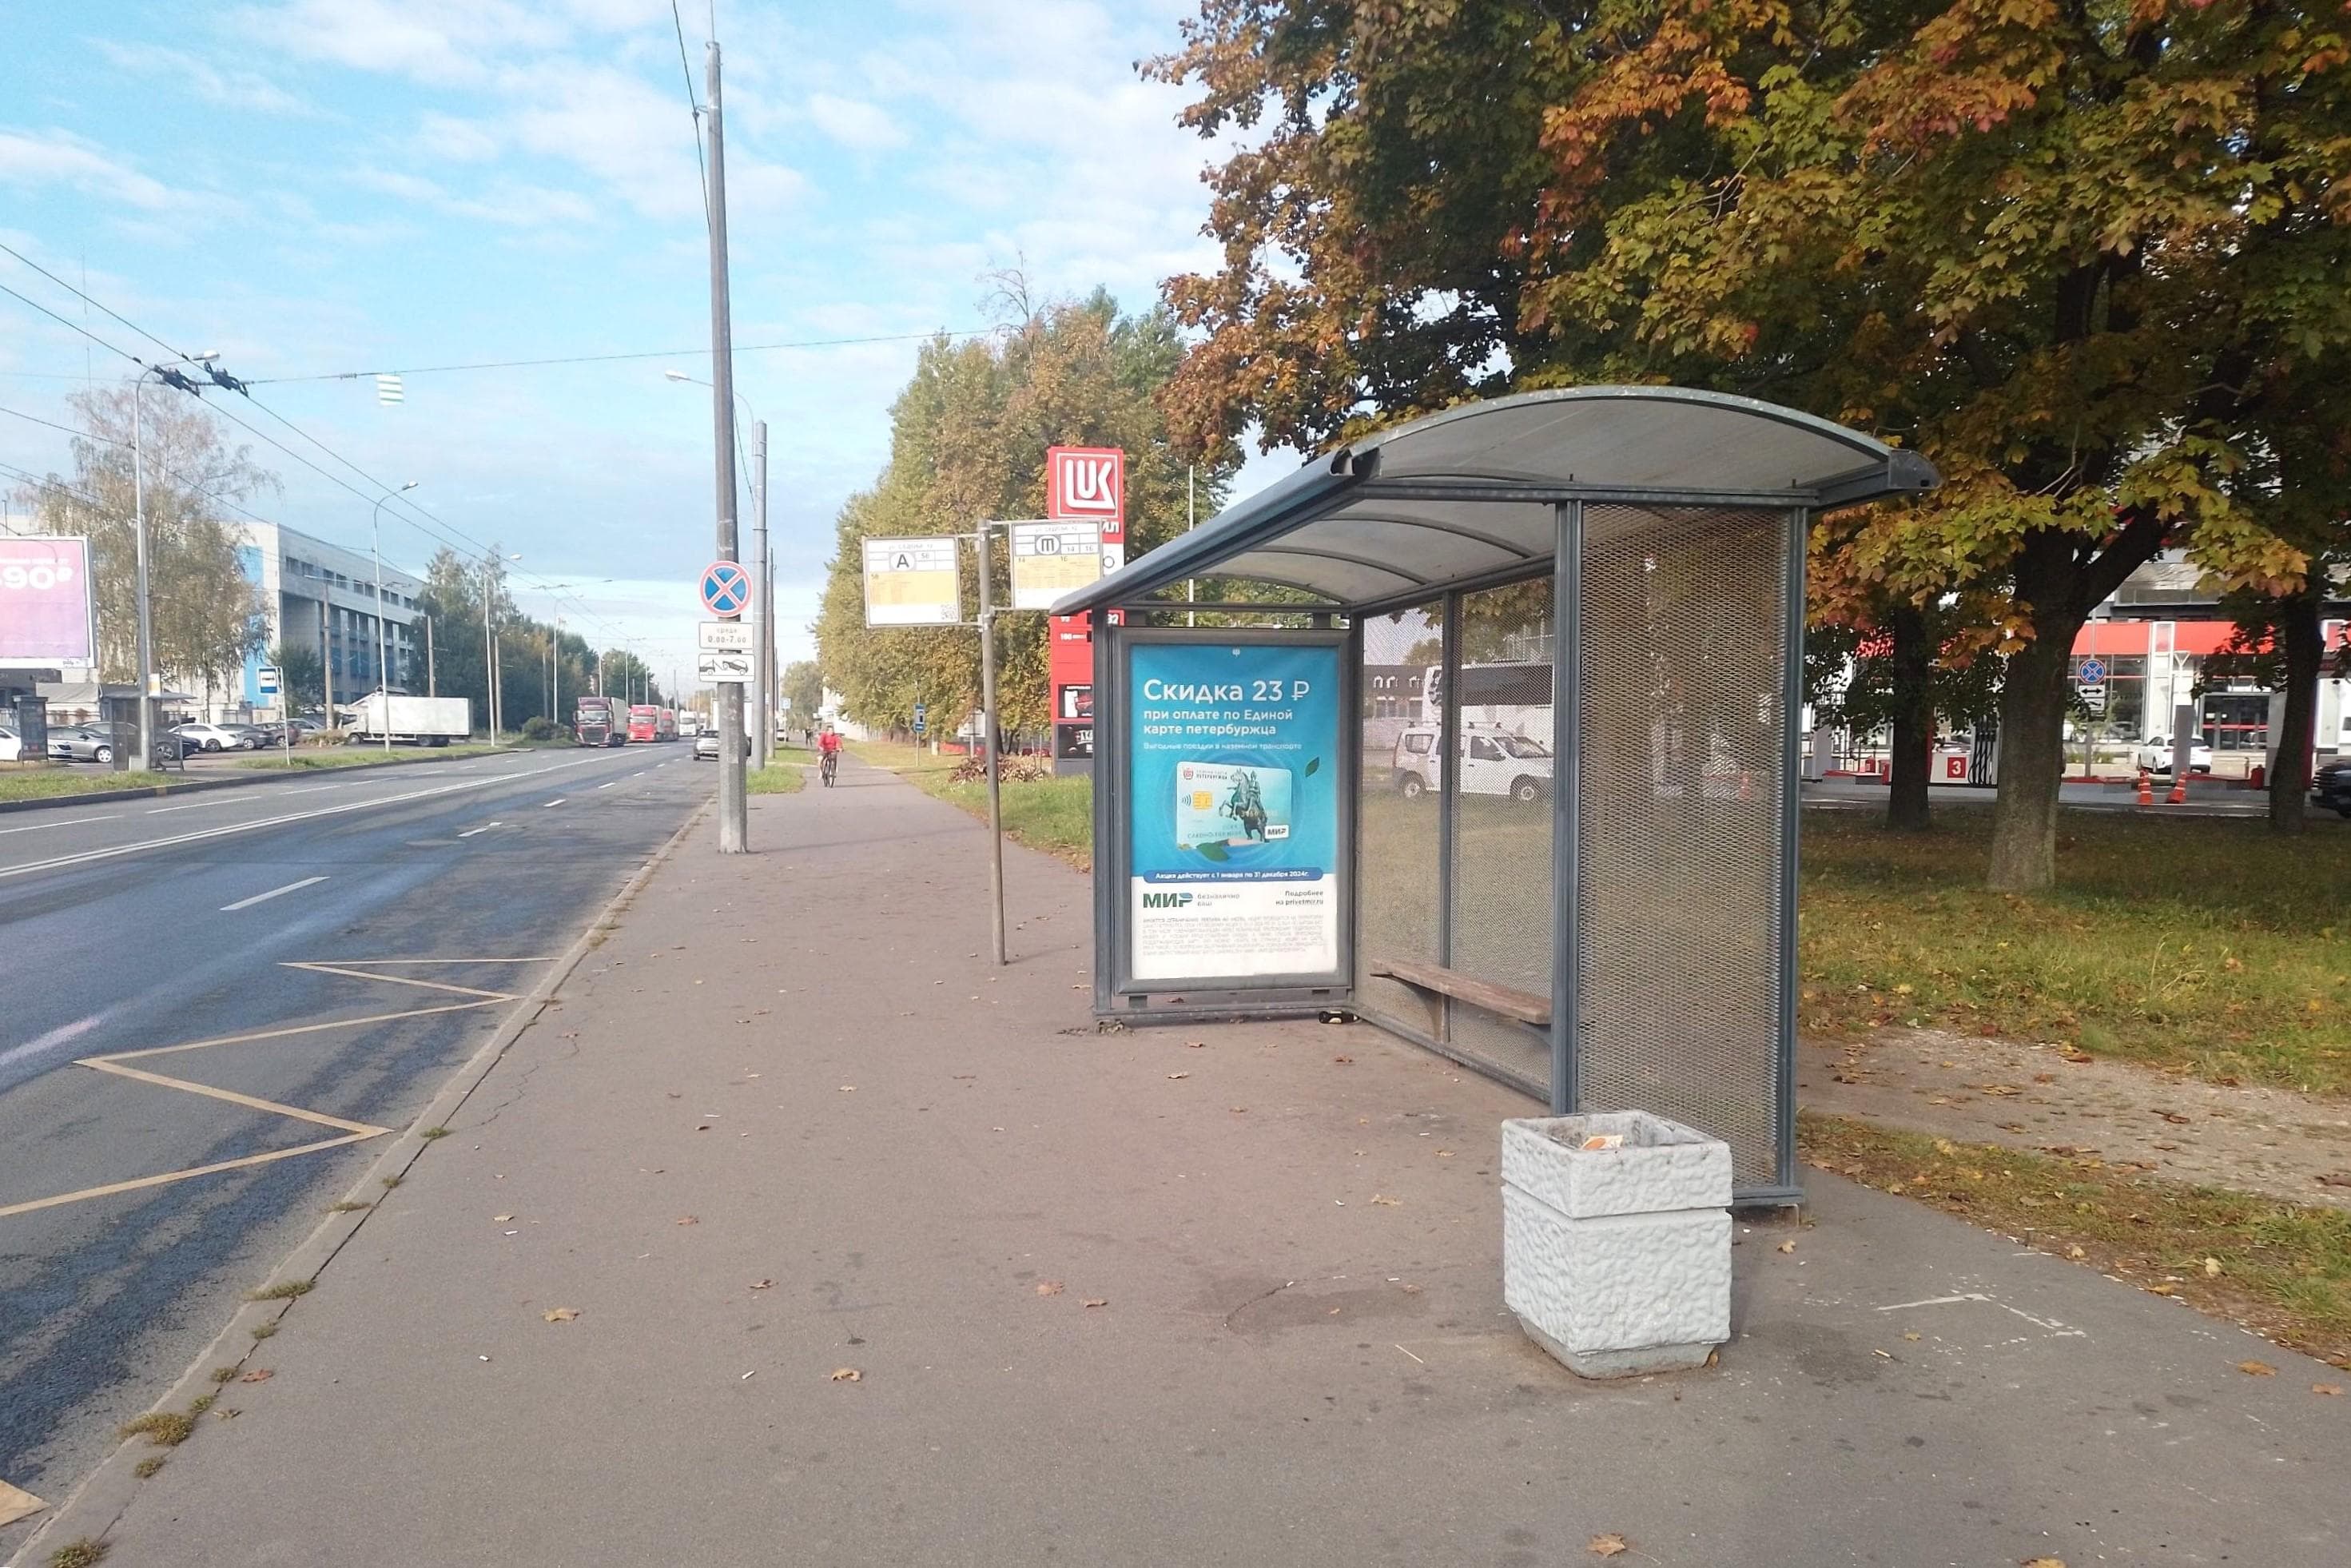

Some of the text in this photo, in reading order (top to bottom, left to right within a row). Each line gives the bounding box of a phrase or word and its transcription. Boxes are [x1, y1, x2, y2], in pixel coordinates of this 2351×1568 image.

[1144, 679, 1243, 704] Скидка
[1252, 680, 1283, 701] 23
[1144, 708, 1293, 722] при оплате по Единой
[1144, 722, 1276, 736] карте петербуржца
[1951, 760, 1961, 775] 3
[1143, 892, 1193, 908] МИР
